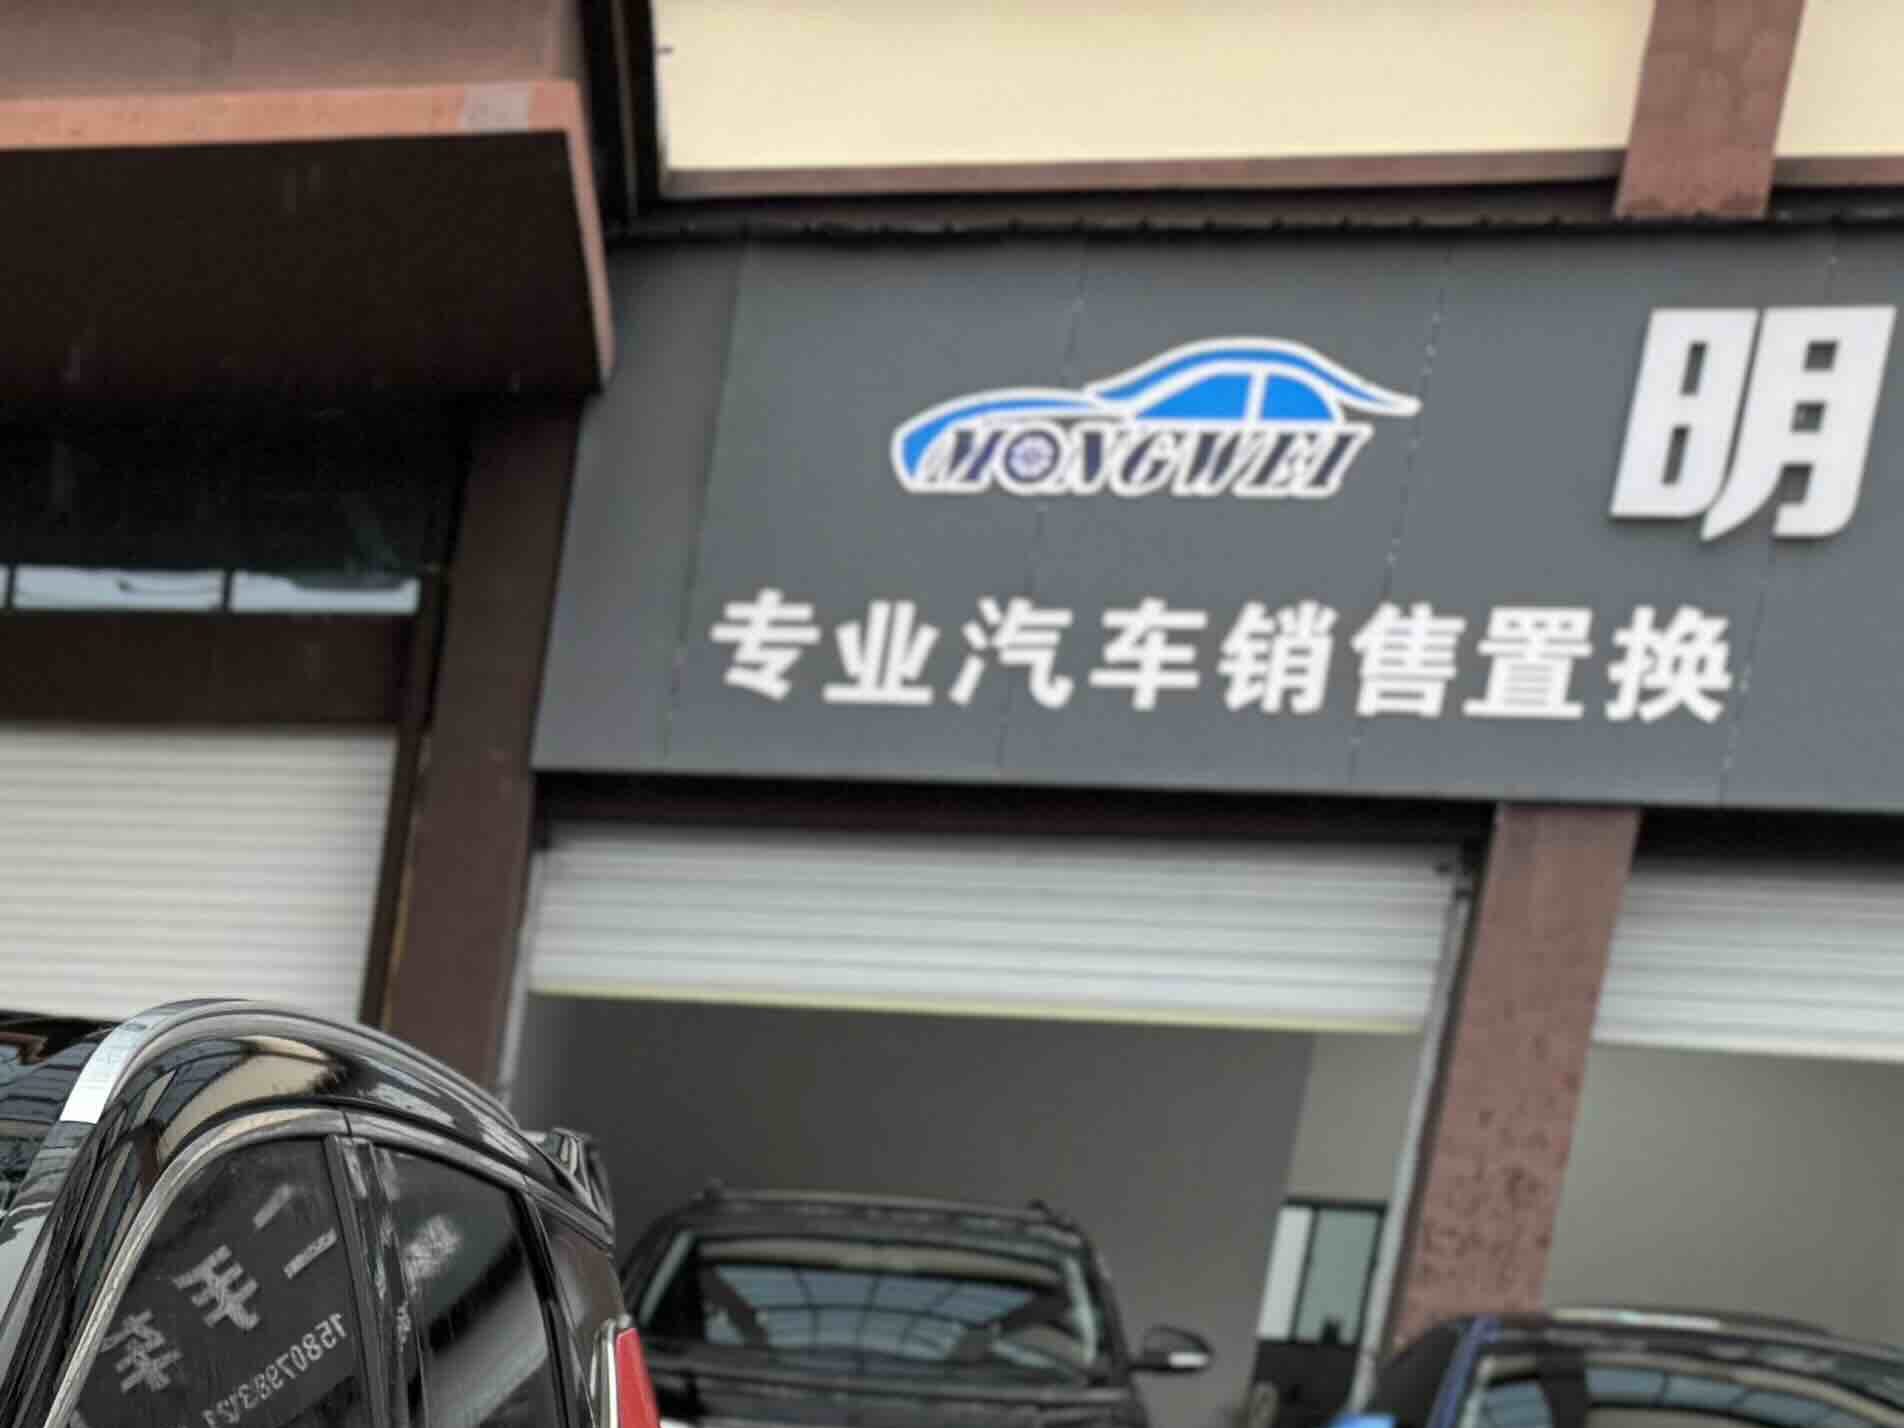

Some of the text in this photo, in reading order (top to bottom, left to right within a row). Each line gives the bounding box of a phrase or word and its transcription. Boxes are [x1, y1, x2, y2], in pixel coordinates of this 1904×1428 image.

[1610, 305, 1897, 542] 明
[711, 589, 1733, 722] 专业汽车销售置换
